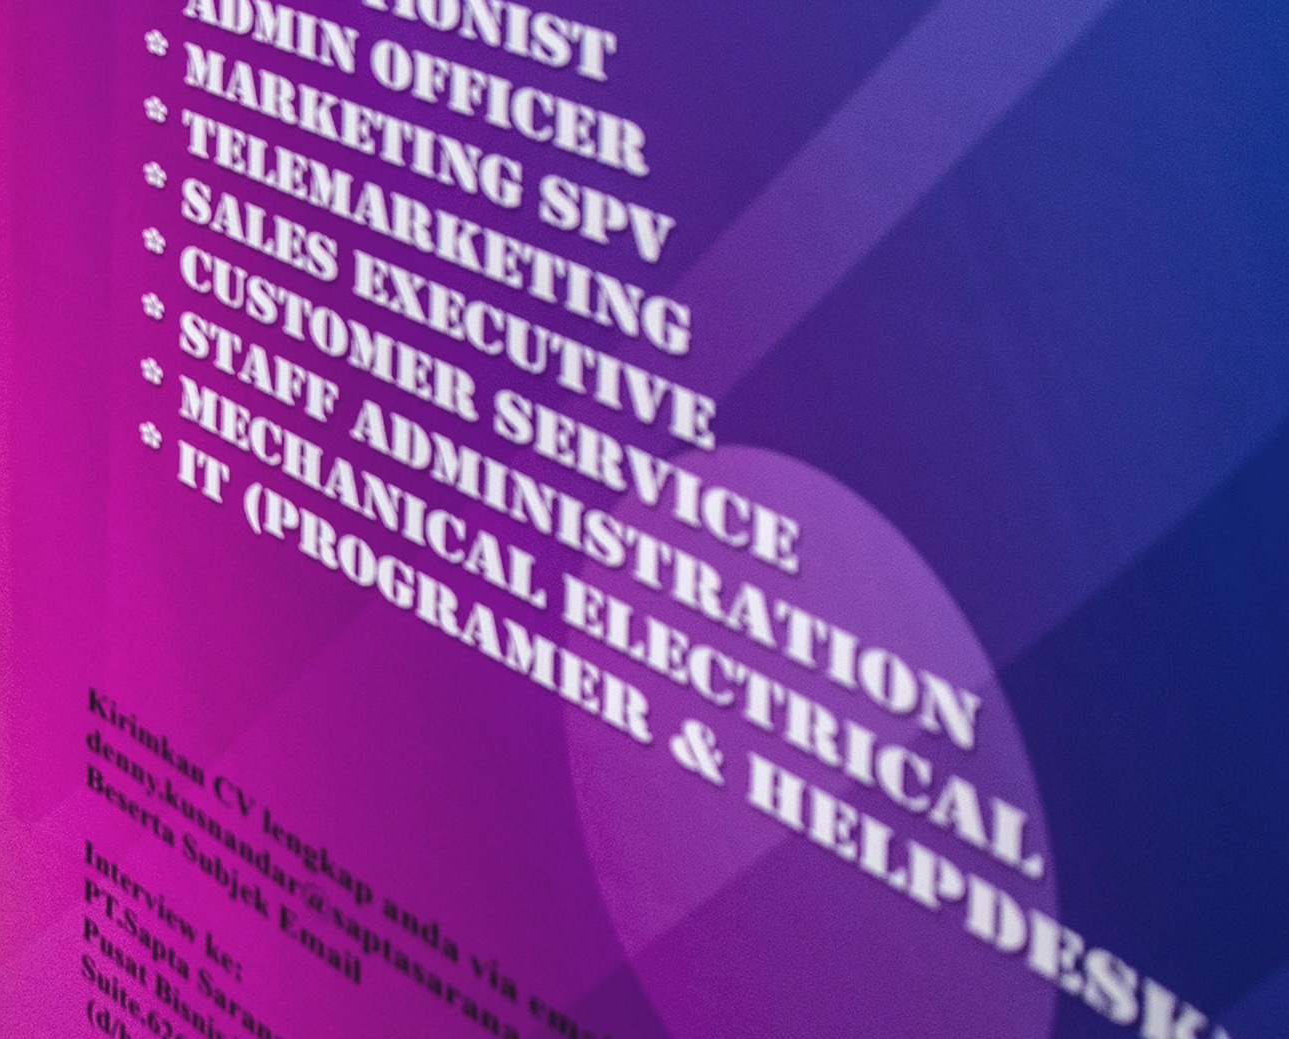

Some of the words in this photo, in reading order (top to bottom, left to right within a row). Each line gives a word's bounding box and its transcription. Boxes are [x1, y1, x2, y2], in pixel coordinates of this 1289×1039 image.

[181, 110, 692, 355] TELEMARKETING
[183, 41, 524, 209] MARKETING
[539, 174, 676, 263] SPV
[370, 38, 651, 177] OFFICER
[179, 245, 480, 422] CUSTOMER
[493, 387, 801, 575] SERVICE
[180, 177, 339, 282] SALES
[352, 248, 717, 451] EXECUTIVE
[177, 439, 230, 504] IT
[243, 481, 653, 744] (PROGRAMER
[670, 718, 725, 787] &
[178, 311, 341, 424] STAFF
[350, 398, 982, 751] ADMINISTRATION
[178, 374, 547, 610] MECHANICAL
[562, 571, 1045, 879] ELECTRICAL
[83, 915, 147, 986] Pusat
[85, 839, 195, 944] Interview
[86, 763, 175, 848] Beserta
[182, 833, 270, 920] Subjek
[279, 904, 361, 987] Email
[88, 686, 205, 788] Kirimkan
[213, 774, 257, 817] CV
[263, 807, 374, 906] lengkap
[382, 897, 460, 965] anda
[470, 953, 518, 1005] via
